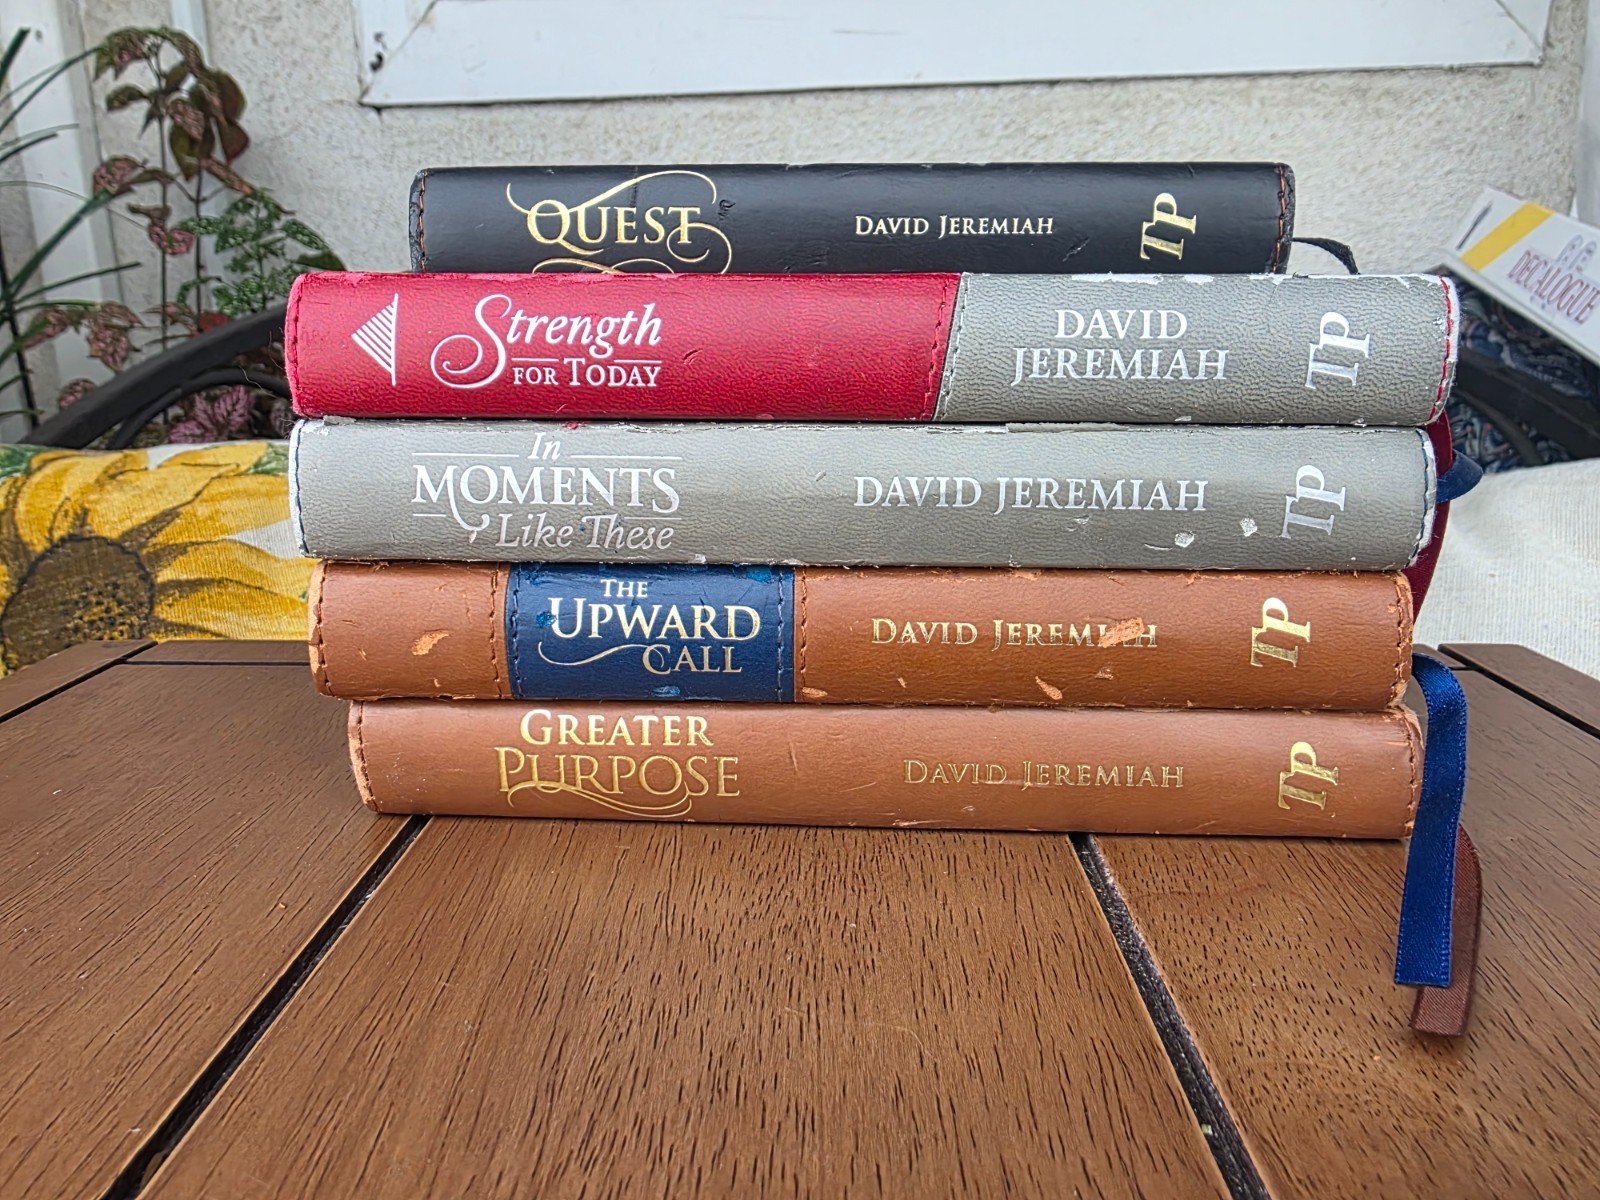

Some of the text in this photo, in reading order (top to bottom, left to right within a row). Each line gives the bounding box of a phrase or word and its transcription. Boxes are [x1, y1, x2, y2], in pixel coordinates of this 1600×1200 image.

[855, 215, 1054, 239] DAVID JEREMIAH
[1508, 250, 1600, 324] DECALOGUE
[430, 294, 662, 389] Strength
[1054, 309, 1188, 340] DAVID
[512, 359, 661, 387] FOR TODAY
[1010, 347, 1230, 386] JEREMIAH
[528, 432, 561, 461] In
[411, 464, 681, 531] MOMENTS
[854, 476, 1208, 516] DAVID JEREMIAH
[495, 512, 674, 550] Like These
[601, 578, 648, 599] THE
[547, 598, 761, 641] UPWARD
[872, 618, 978, 645] DAVID
[642, 644, 743, 675] CALL
[520, 709, 714, 746] GREATER
[494, 746, 741, 806] PURPOSE
[903, 759, 1184, 791] DAVID JEREMIAH
